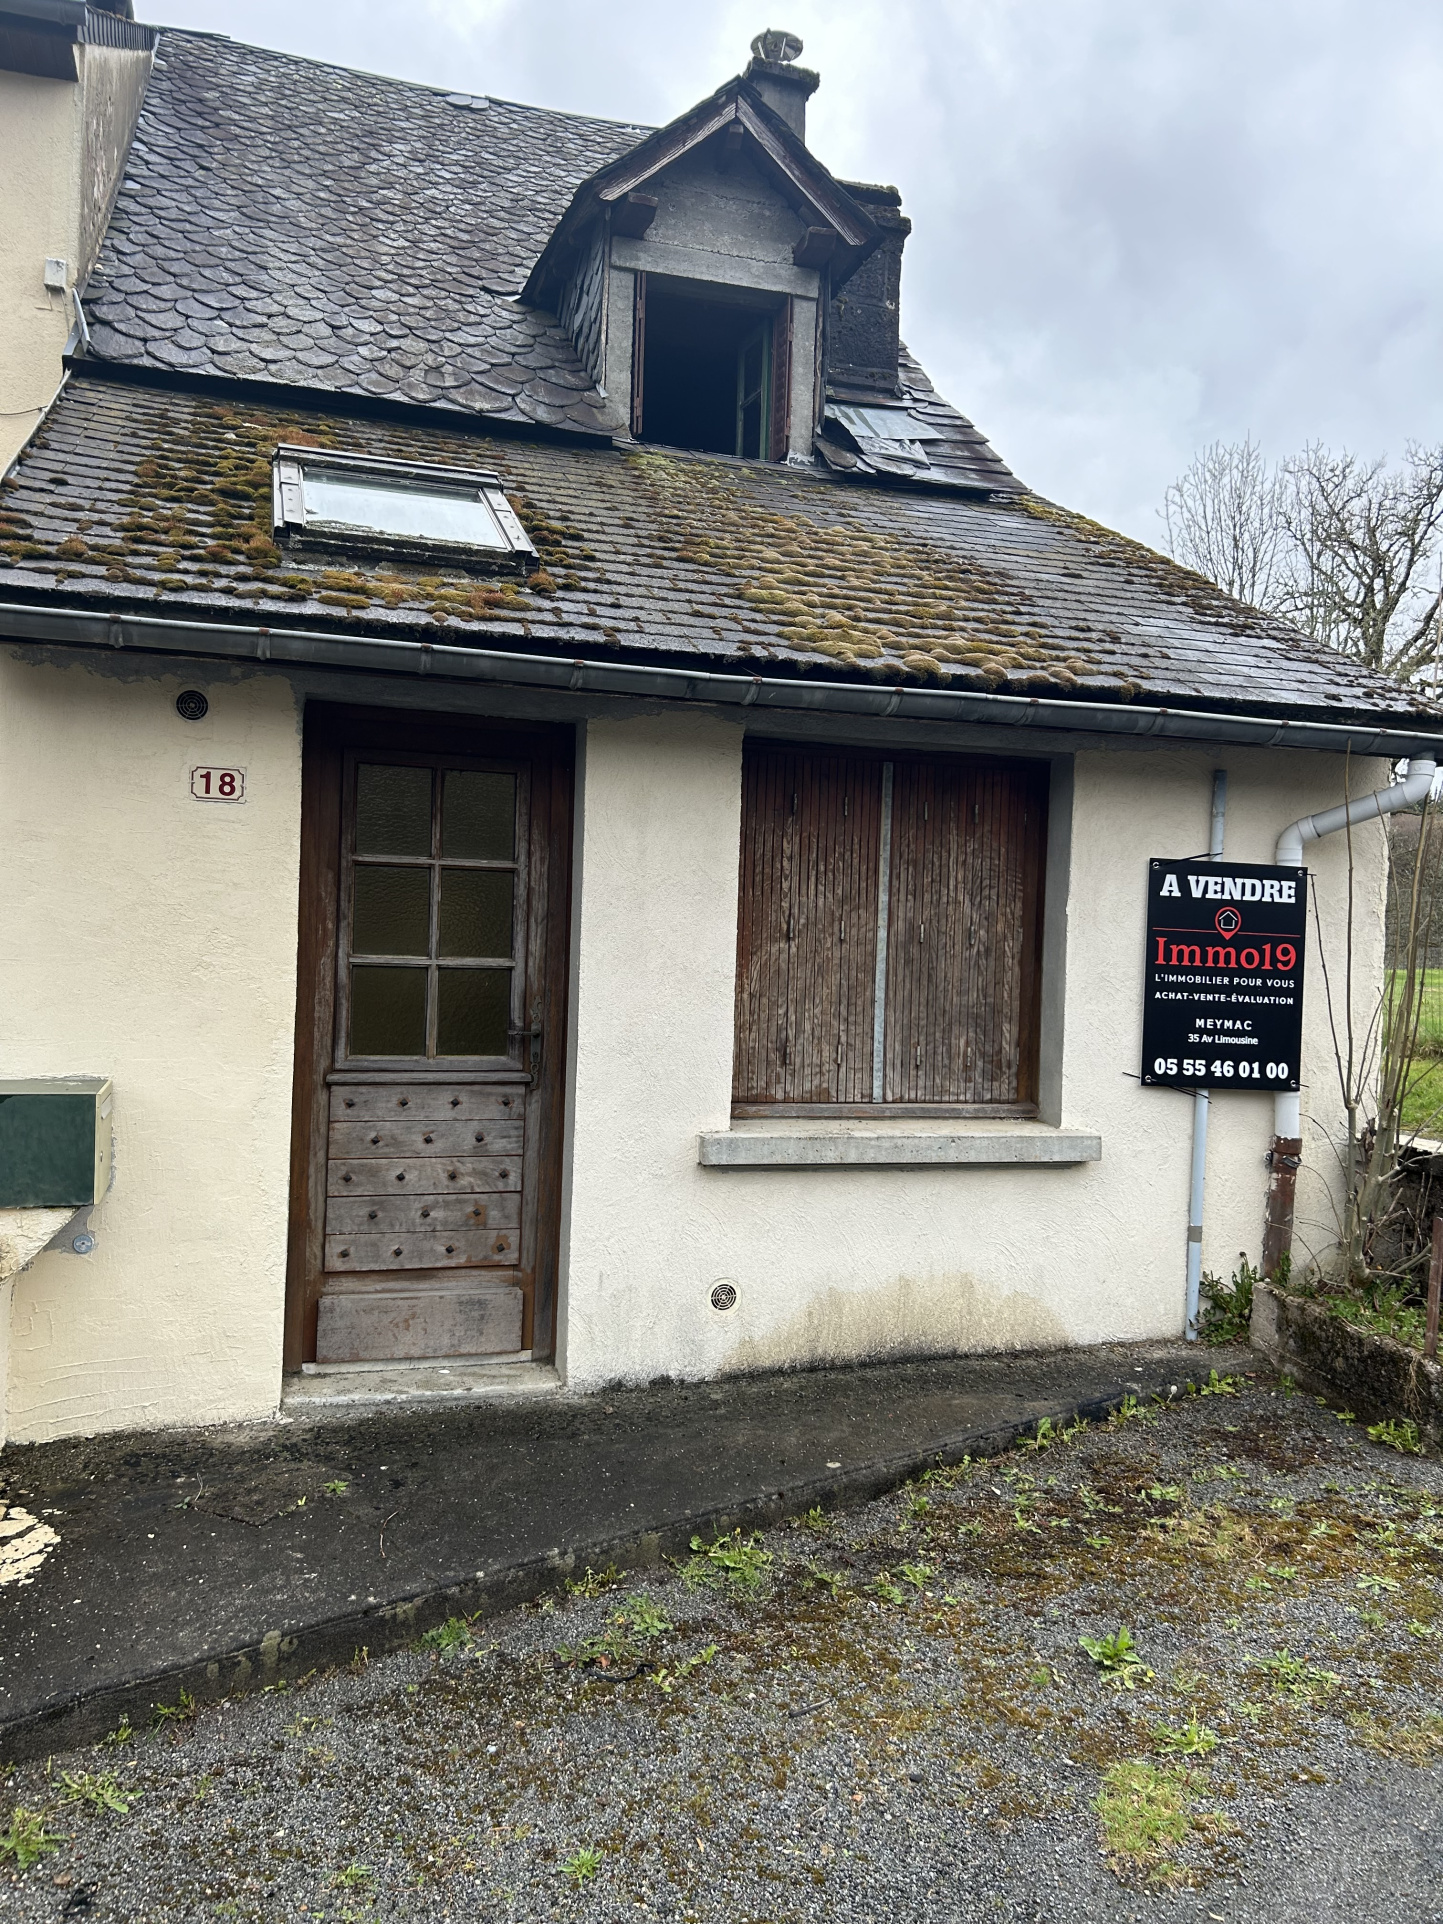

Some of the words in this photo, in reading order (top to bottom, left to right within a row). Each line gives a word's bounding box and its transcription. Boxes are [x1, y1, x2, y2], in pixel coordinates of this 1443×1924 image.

[200, 771, 236, 796] 18
[1160, 874, 1181, 897] A
[1187, 875, 1296, 903] VENDRE
[1155, 937, 1296, 970] Immo19
[1155, 974, 1229, 985] L'IMMOBILIER
[1233, 977, 1262, 986] POUR
[1266, 979, 1295, 988] VOUS
[1155, 991, 1294, 1005] ACHAT-VENTE-ÉVALUATION
[1195, 1018, 1252, 1030] MEYMAC
[1188, 1034, 1199, 1042] 35
[1201, 1034, 1213, 1043] Av
[1215, 1035, 1258, 1045] Limousine
[1154, 1058, 1178, 1075] 05
[1182, 1059, 1206, 1076] 55
[1211, 1060, 1234, 1077] 46
[1238, 1061, 1261, 1078] 01
[1266, 1062, 1289, 1079] 00
